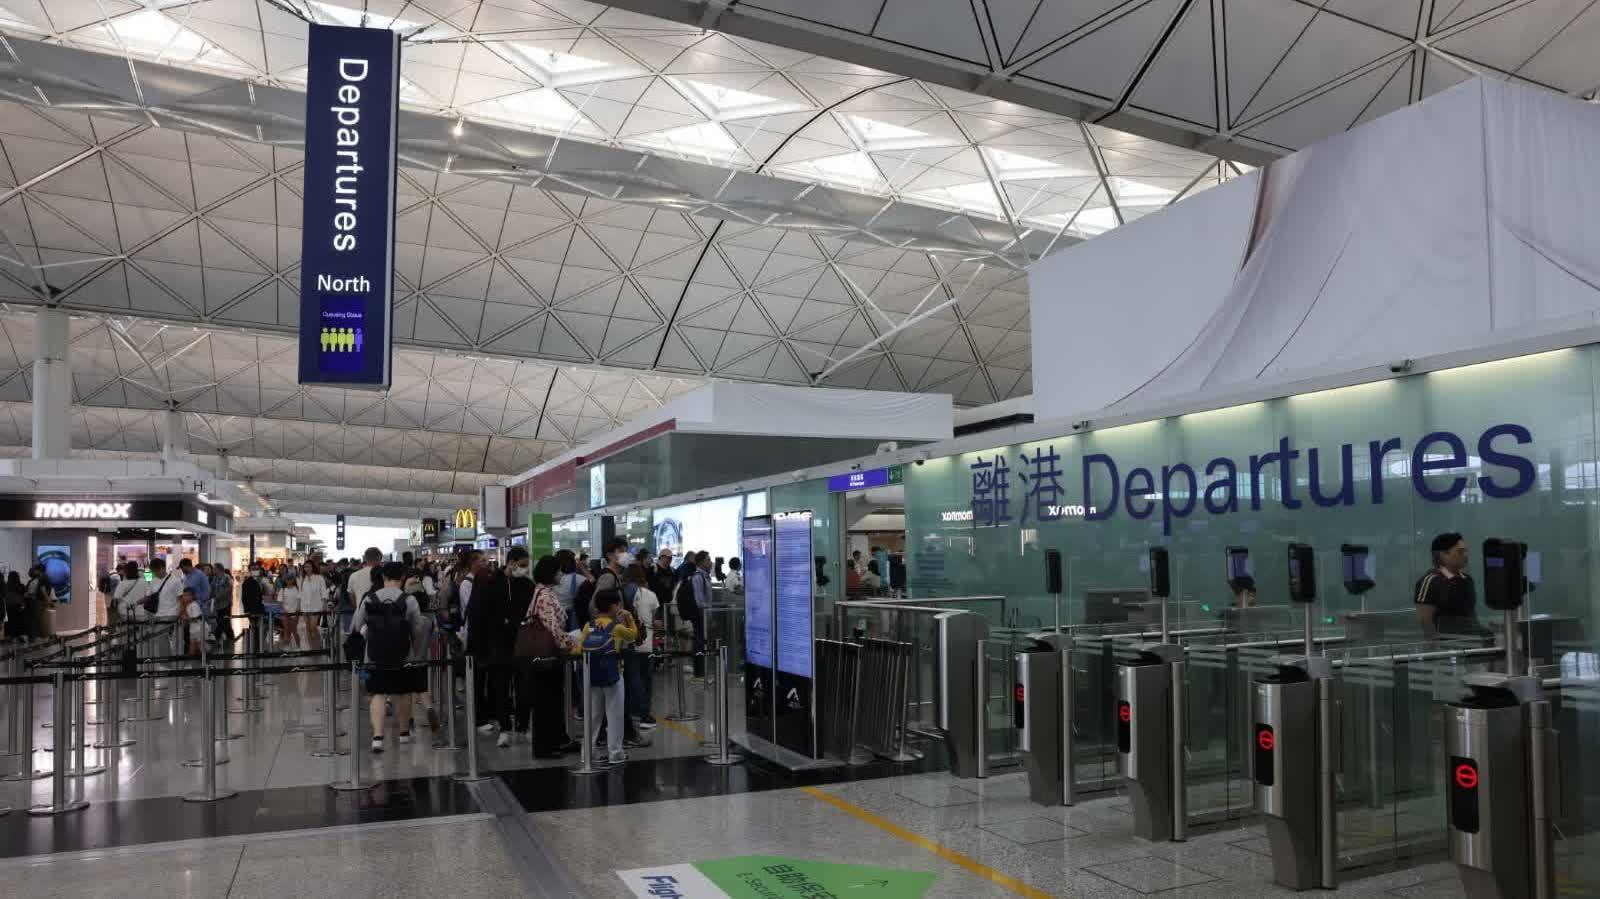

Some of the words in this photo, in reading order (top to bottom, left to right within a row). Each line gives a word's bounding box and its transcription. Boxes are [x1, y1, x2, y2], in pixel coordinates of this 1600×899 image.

[331, 57, 369, 252] Departures
[317, 274, 371, 293] North
[34, 502, 132, 519] momax
[970, 445, 1065, 530] 離港
[1082, 423, 1536, 536] Departures
